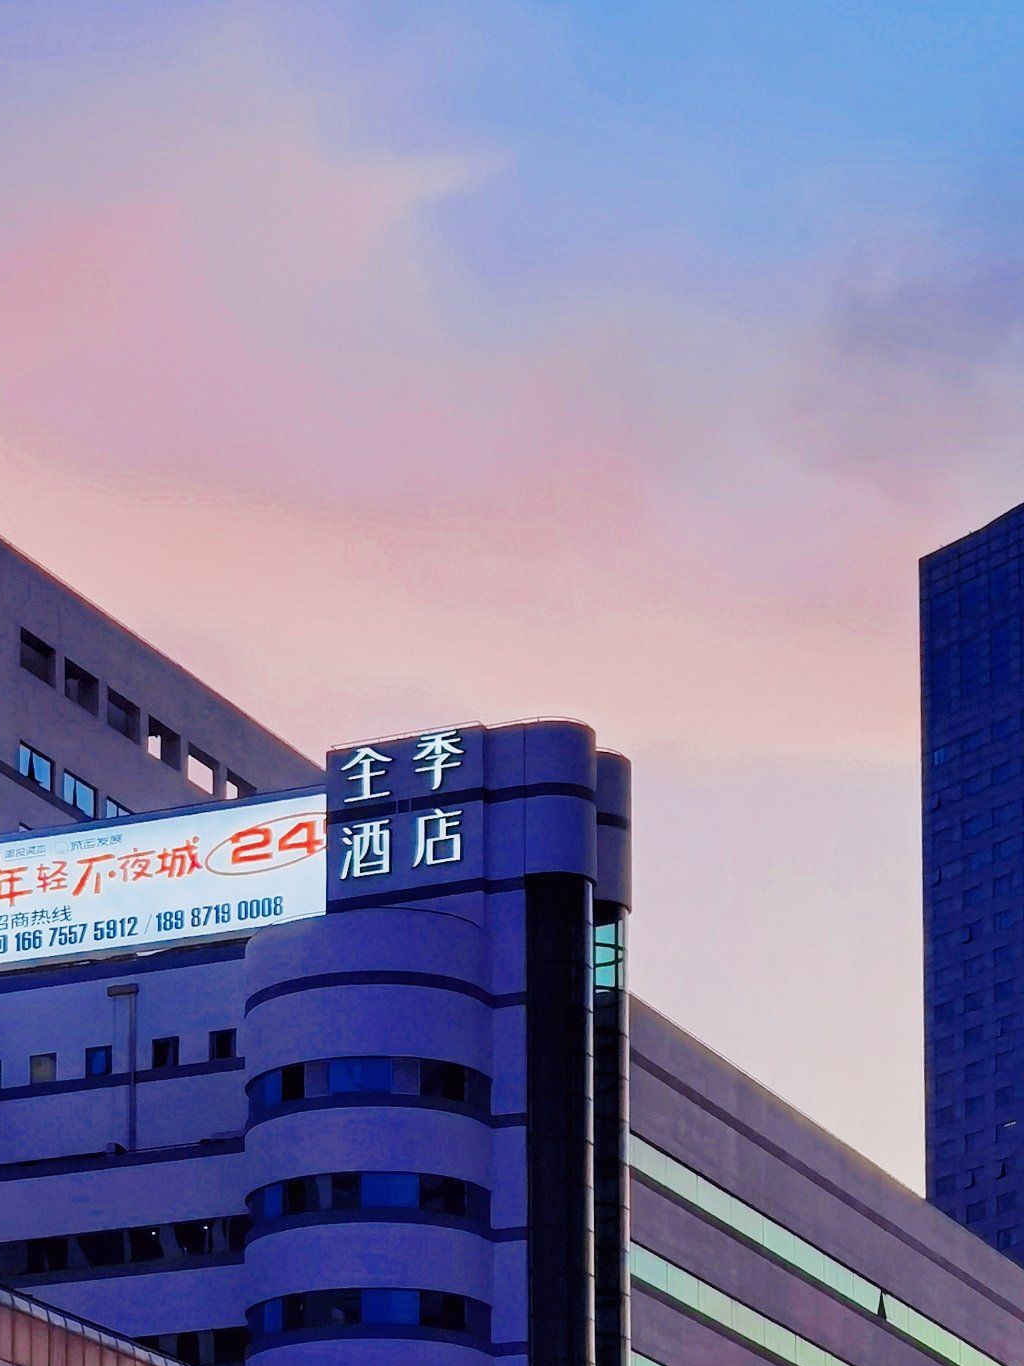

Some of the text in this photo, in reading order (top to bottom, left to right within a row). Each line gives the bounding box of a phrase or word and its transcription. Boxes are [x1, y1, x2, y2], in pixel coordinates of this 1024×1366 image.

[341, 730, 464, 803] 全季
[340, 808, 463, 880] 酒店
[15, 929, 44, 952] 166
[49, 923, 88, 947] 7557
[93, 916, 138, 941] 5912
[237, 896, 283, 921] 0008
